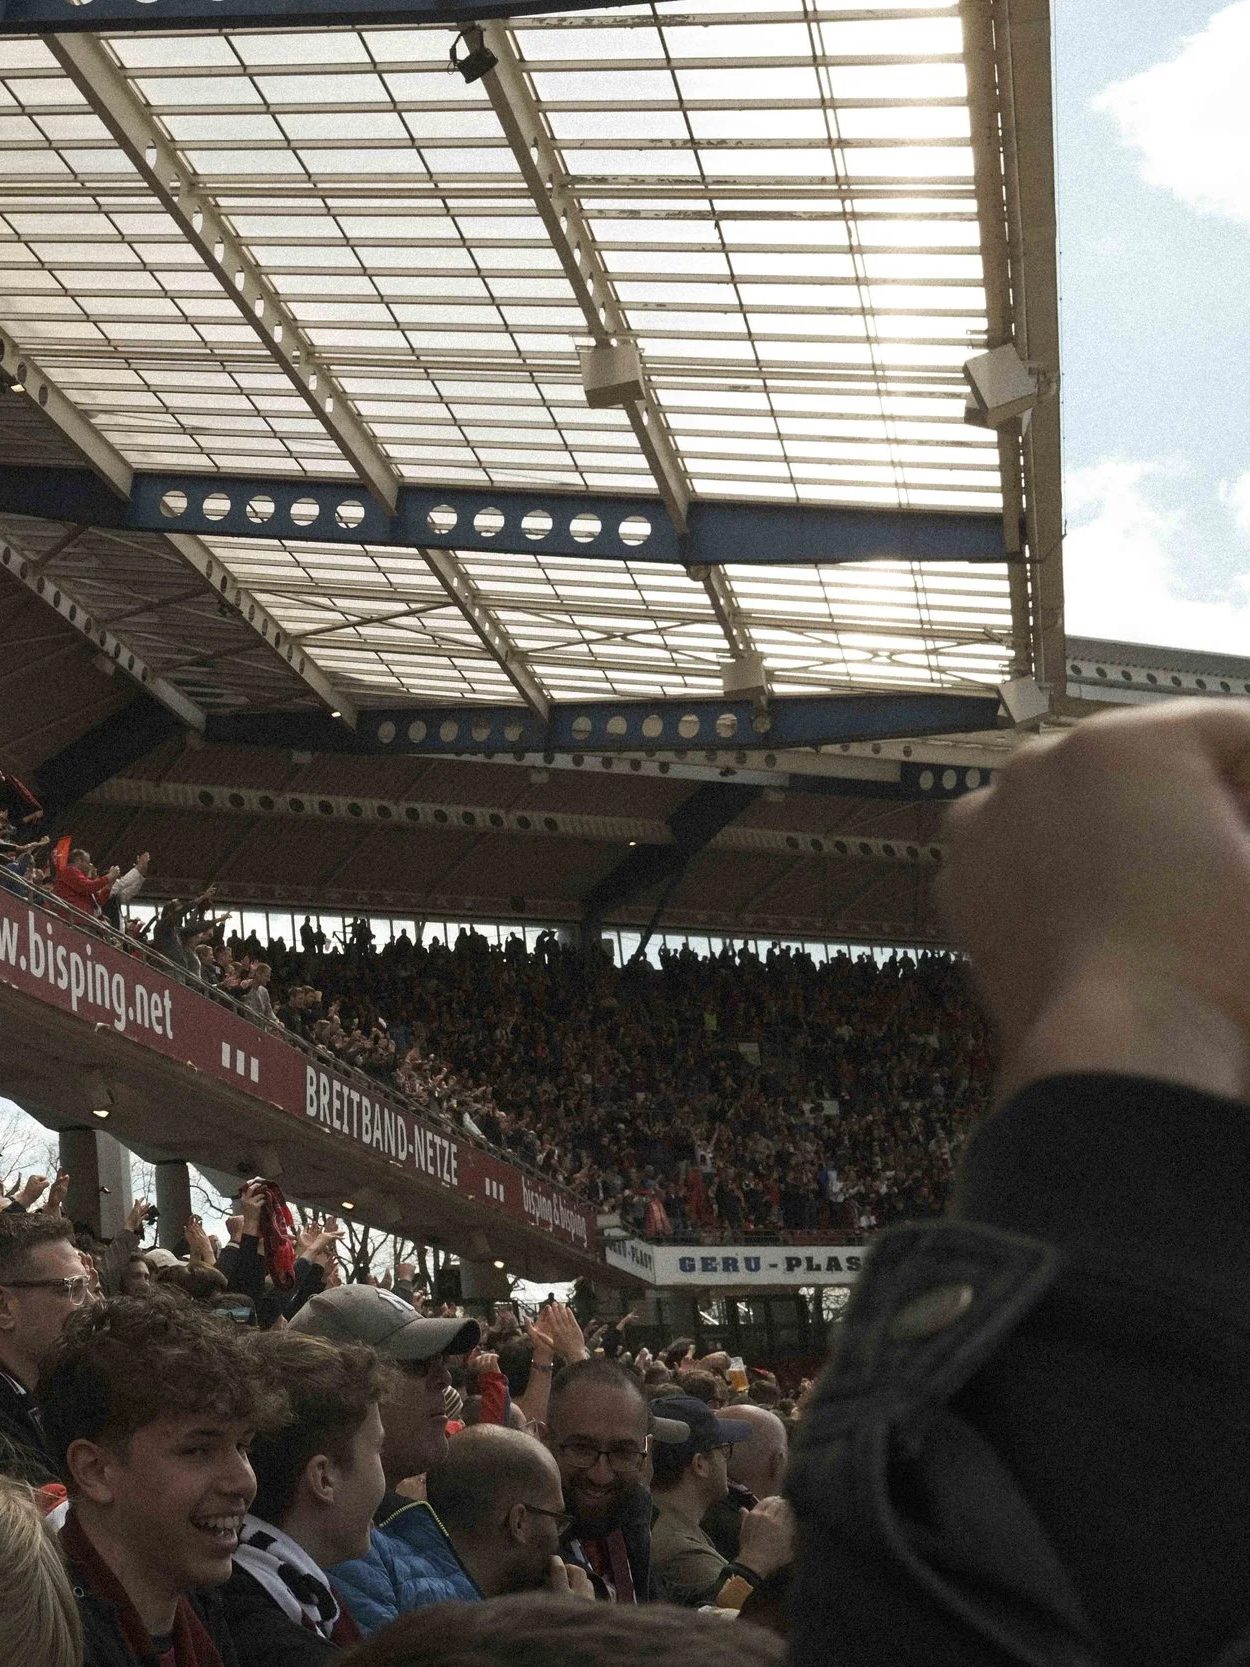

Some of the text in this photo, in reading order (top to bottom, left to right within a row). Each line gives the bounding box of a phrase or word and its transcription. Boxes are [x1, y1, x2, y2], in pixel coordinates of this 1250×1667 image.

[306, 1065, 458, 1186] BREITBAND-NETZE
[521, 1175, 553, 1233] bisping
[558, 1195, 588, 1248] bisping
[678, 1256, 761, 1273] GERU
[784, 1256, 862, 1273] PLAS
